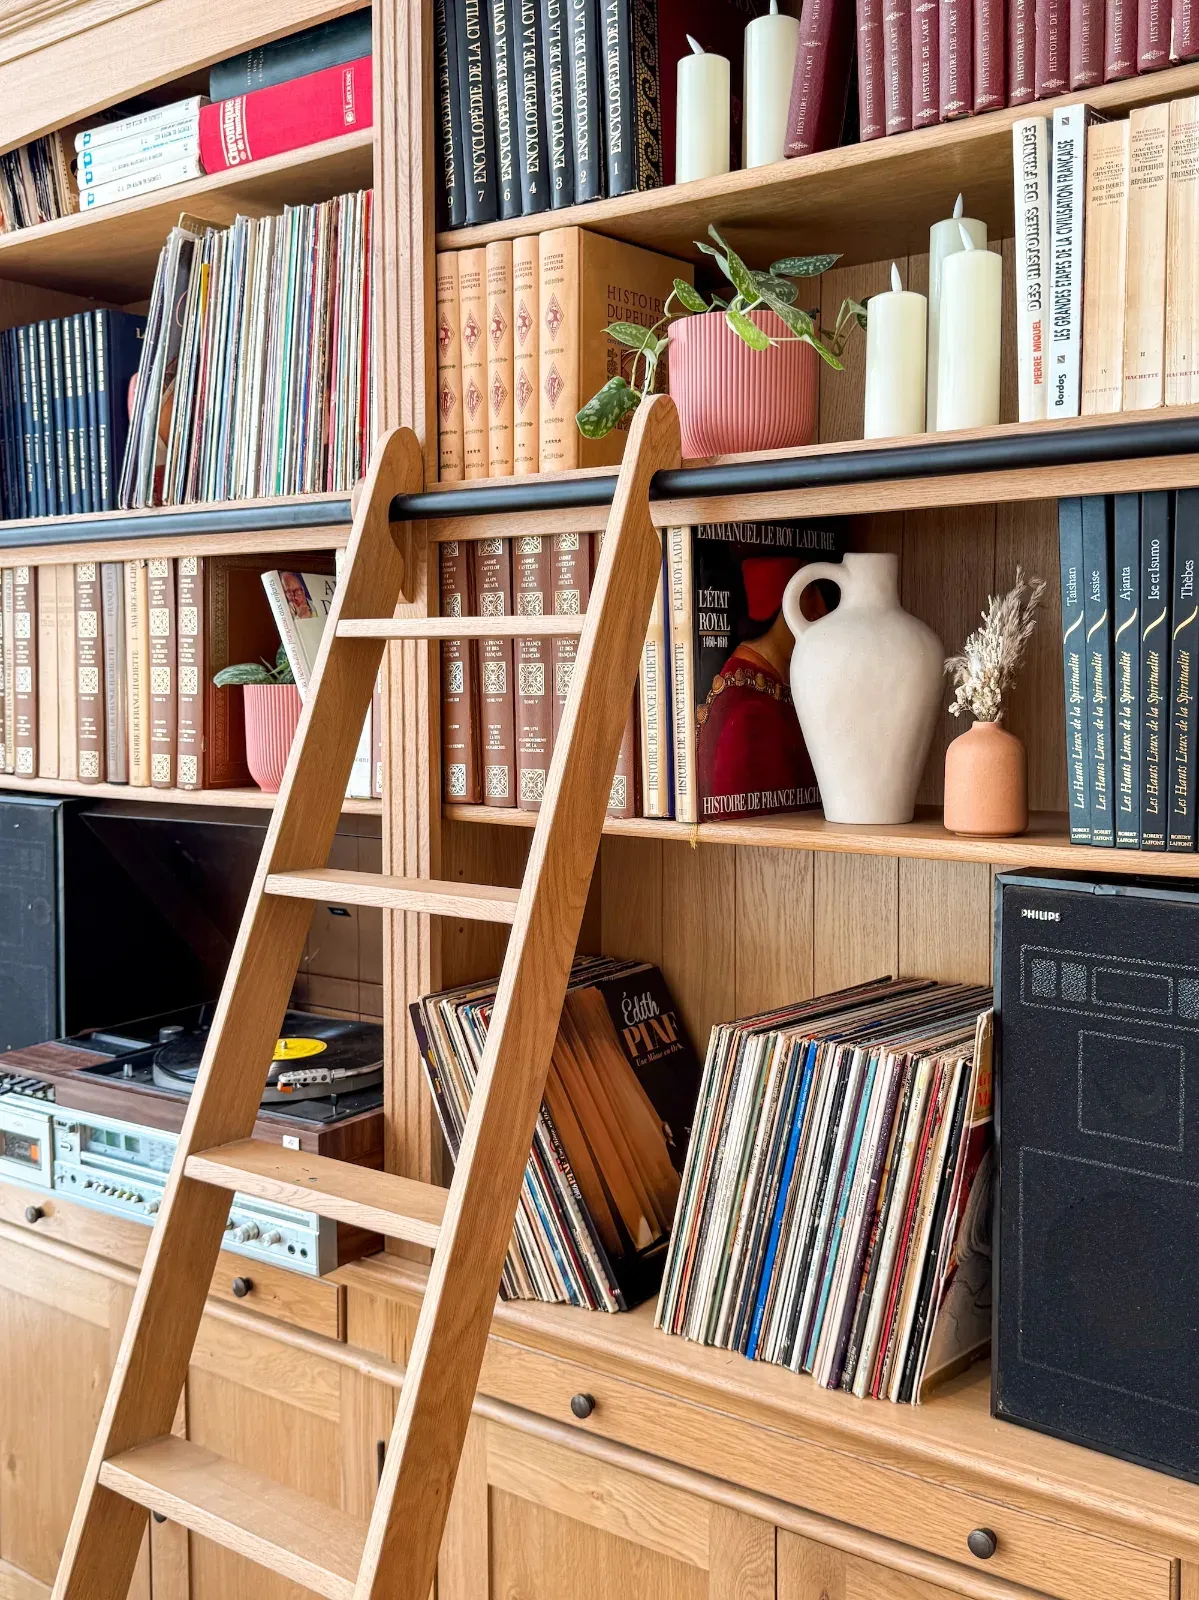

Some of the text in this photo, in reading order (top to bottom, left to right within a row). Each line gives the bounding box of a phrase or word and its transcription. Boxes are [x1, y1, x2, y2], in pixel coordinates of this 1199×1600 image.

[864, 37, 872, 61] L'ART
[981, 27, 990, 43] DE
[1016, 22, 1025, 81] HISTOIRE DE
[1049, 13, 1058, 72] HISTOIRE DE
[1081, 2, 1090, 64] HISTOIRE DE
[1114, 9, 1123, 54] HISTOIRE
[865, 63, 873, 78] DE
[890, 27, 900, 111] HISTOIRE DE L'ART
[921, 18, 930, 102] HISTOIRE DE L'ART
[948, 9, 957, 95] HISTOIRE DE L'ART
[981, 43, 990, 88] HISTOIRE
[344, 70, 352, 110] Larousse
[549, 21, 565, 170] ENCYCLOPÉDIE DE LA
[574, 11, 589, 163] ENCYCLOPÉDIE DE LA
[607, 1, 622, 155] ENCYCLOPÉDIE DE LA
[468, 41, 487, 184] ENCYCLOPÉDIE DE LA
[495, 37, 512, 182] ENCYCLOPÉDIE DE LA
[523, 27, 540, 174] ENCYCLOPÉDIE DE LA
[796, 97, 808, 135] HISTOIRE
[802, 81, 810, 94] DE
[866, 81, 874, 118] HISTOIRE
[223, 99, 240, 165] Chronique
[529, 181, 537, 194] 4
[555, 176, 563, 190] 3
[580, 170, 587, 184] 2
[613, 161, 619, 175] 1
[477, 190, 485, 202] 7
[504, 188, 511, 201] 6
[1022, 125, 1041, 311] DES HISTOIRES DE FRANCE
[1051, 139, 1078, 342] LES GRANDES ÉTAPES DE LA CIVILISATION FRANÇAISE
[607, 303, 623, 321] DU
[1033, 319, 1043, 385] PIERRE MIQUEL
[1054, 373, 1067, 406] Bordas
[1125, 373, 1160, 381] HACHETTE
[697, 522, 836, 551] EMMANUEL LE ROY LADURIE
[266, 578, 281, 604] enfants
[672, 567, 684, 586] ROY
[673, 586, 684, 601] LE
[1066, 567, 1078, 607] Taishan
[1090, 570, 1101, 603] Assise
[1119, 566, 1134, 601] Ajanta
[1147, 585, 1160, 600] Ise
[1149, 572, 1160, 584] et
[1180, 559, 1194, 600] Thèbes
[130, 596, 139, 629] MAURICE
[275, 602, 285, 617] aux
[698, 585, 731, 609] L'ÉTAT
[698, 611, 731, 632] ROYAL
[131, 650, 141, 767] HISTOIRE DE FRANCE HACHETTE
[645, 640, 659, 791] HISTOIRE DE FRANCE HACHETTE
[674, 643, 687, 796] HISTOIRE DE FRANCE HACHETTE
[1068, 652, 1084, 809] Les Hauts Lieux de la Spiritualité
[1092, 651, 1107, 811] Les Hauts Lieux de la Spiritualité
[1118, 650, 1135, 813] Les Hauts Lieux de la Spiritualité
[1146, 649, 1163, 815] Les Hauts Lieux de la Spiritualité
[1174, 649, 1193, 816] Les Hauts Lieux de la Spiritualité
[702, 789, 796, 815] HISTOIRE DE FRANCE
[1020, 908, 1061, 922] PHILIPS
[621, 991, 660, 1026] Édith
[620, 1011, 680, 1058] PIAF
[635, 1057, 648, 1067] Une
